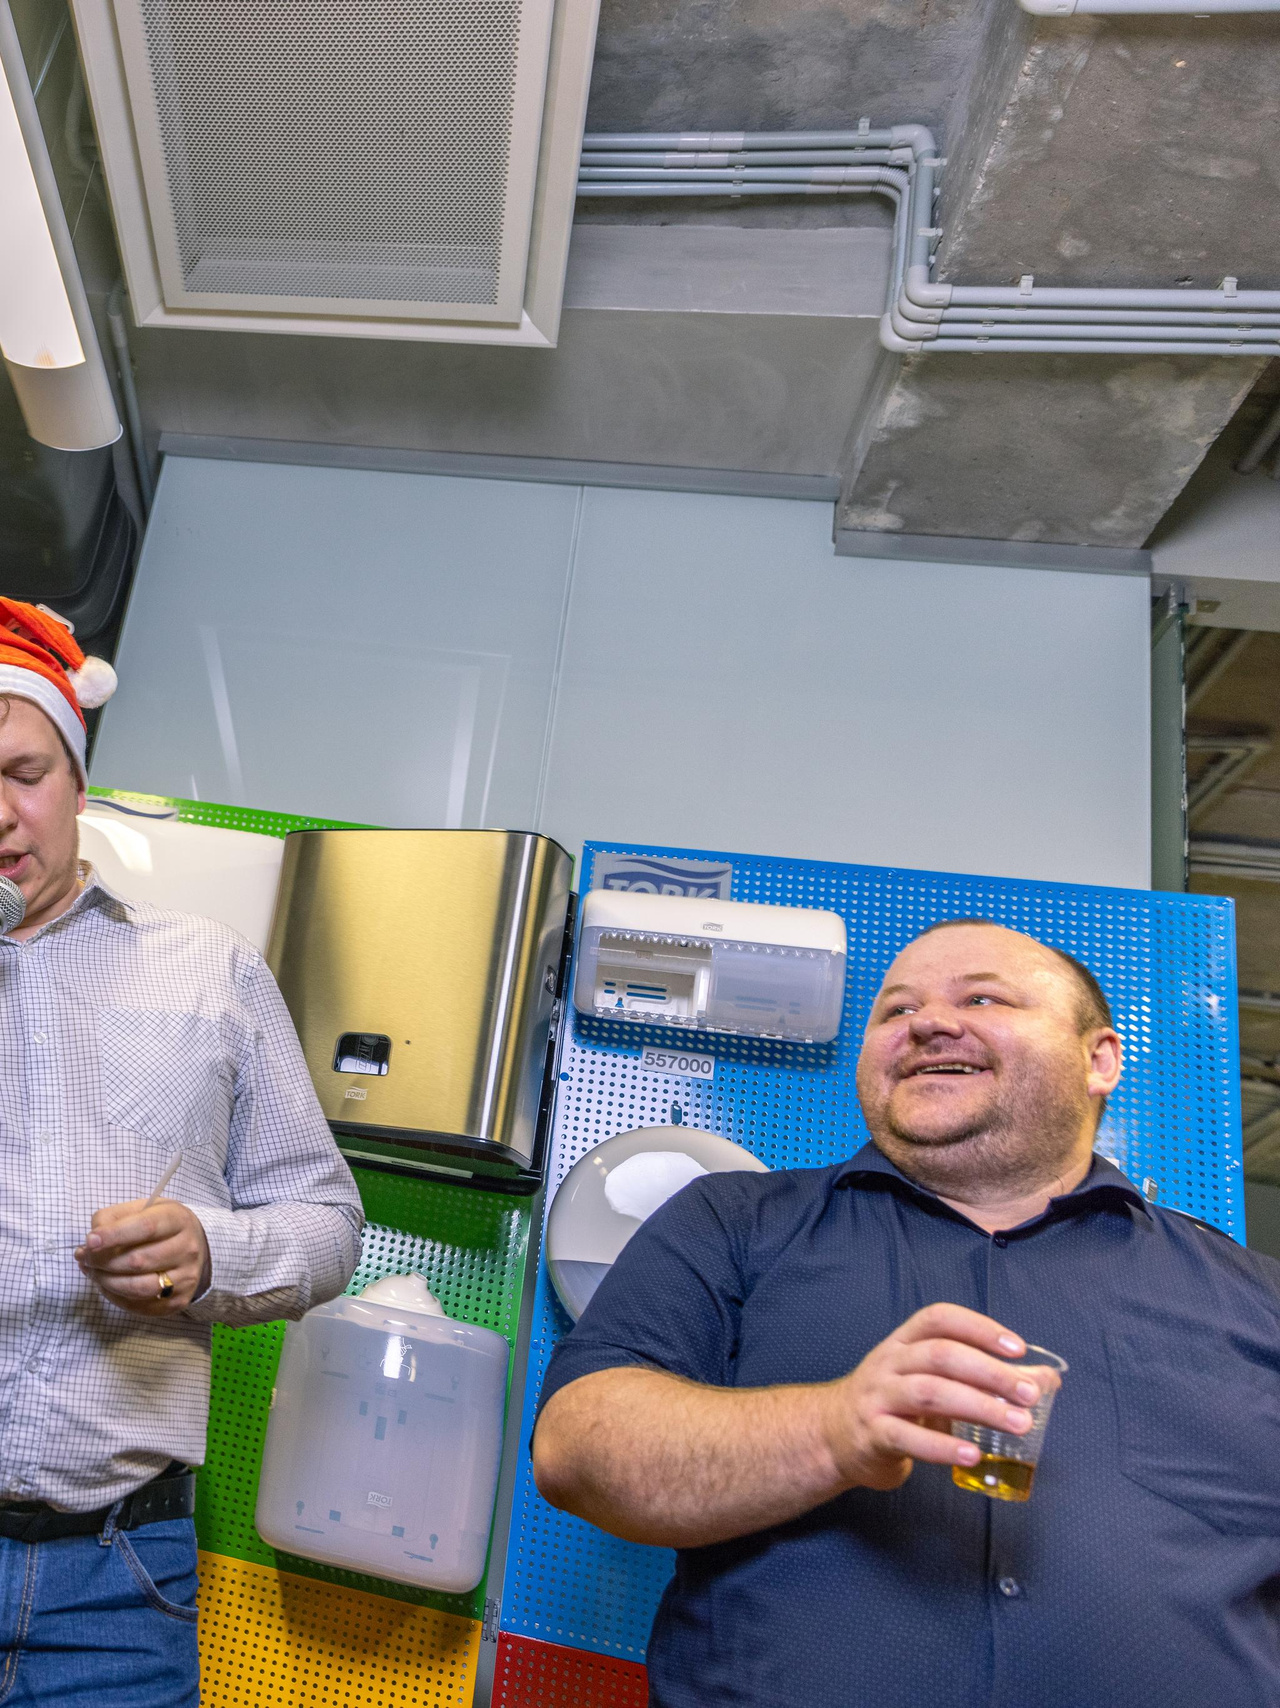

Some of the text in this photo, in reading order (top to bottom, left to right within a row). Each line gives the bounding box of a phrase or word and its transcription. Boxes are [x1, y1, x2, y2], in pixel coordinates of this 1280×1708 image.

[643, 1051, 712, 1074] 557000
[345, 1090, 367, 1099] TORK
[369, 1493, 392, 1505] TORK
